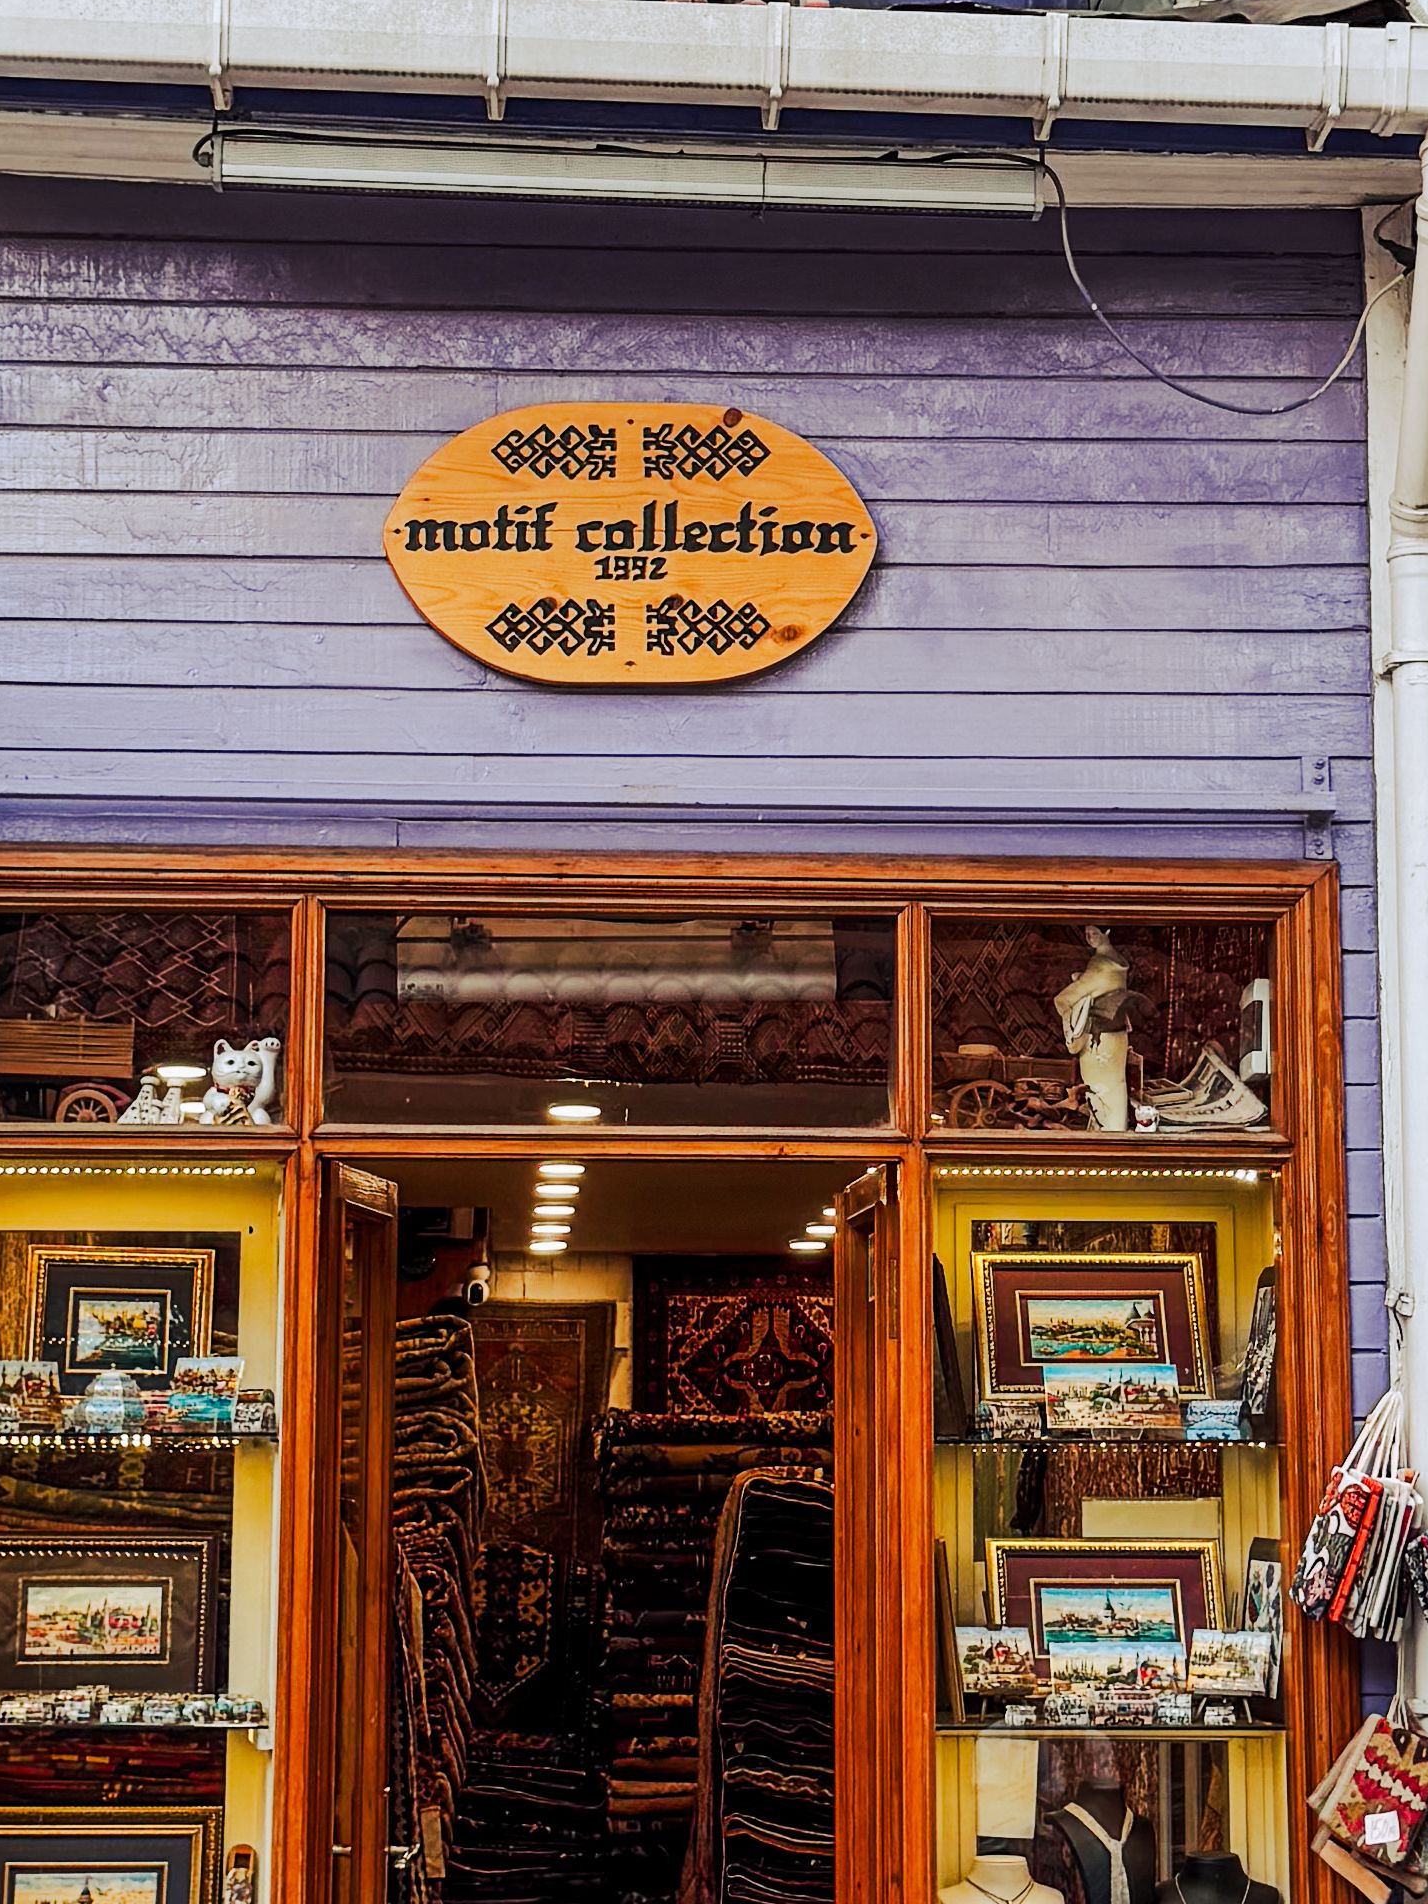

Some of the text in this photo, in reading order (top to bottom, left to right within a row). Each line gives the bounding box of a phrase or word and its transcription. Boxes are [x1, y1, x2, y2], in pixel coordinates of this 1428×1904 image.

[405, 500, 858, 556] motif collection
[594, 556, 669, 582] 1992
